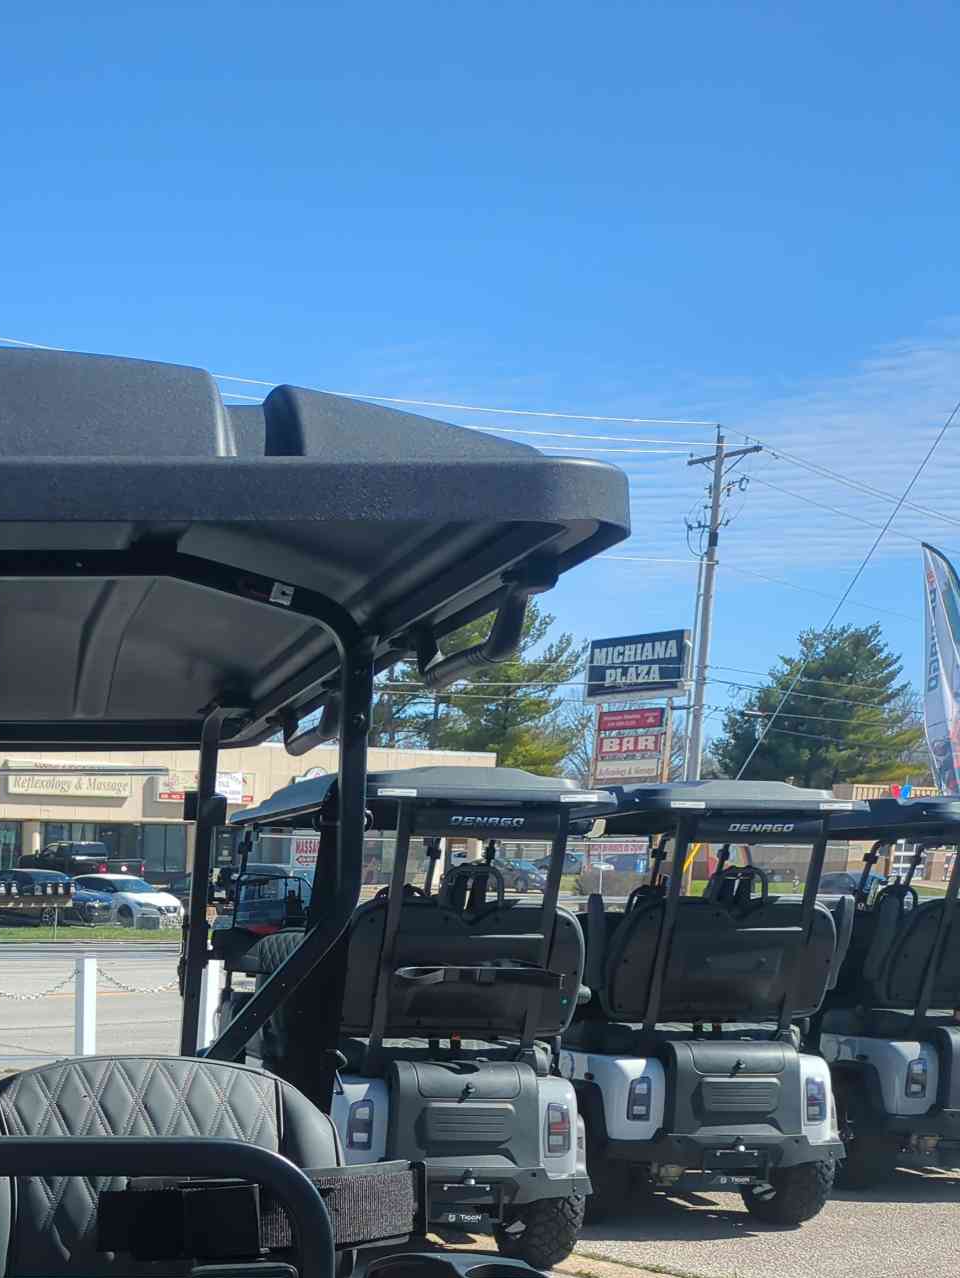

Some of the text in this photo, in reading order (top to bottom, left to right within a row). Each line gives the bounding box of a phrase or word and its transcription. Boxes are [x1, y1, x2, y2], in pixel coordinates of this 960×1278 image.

[593, 639, 678, 665] MICHIANA
[604, 664, 660, 688] PLAZA
[602, 735, 656, 752] BAR
[14, 776, 71, 792] Reflexology
[86, 778, 128, 793] Massage
[451, 816, 525, 826] DENAGO
[727, 823, 794, 832] DENAGO
